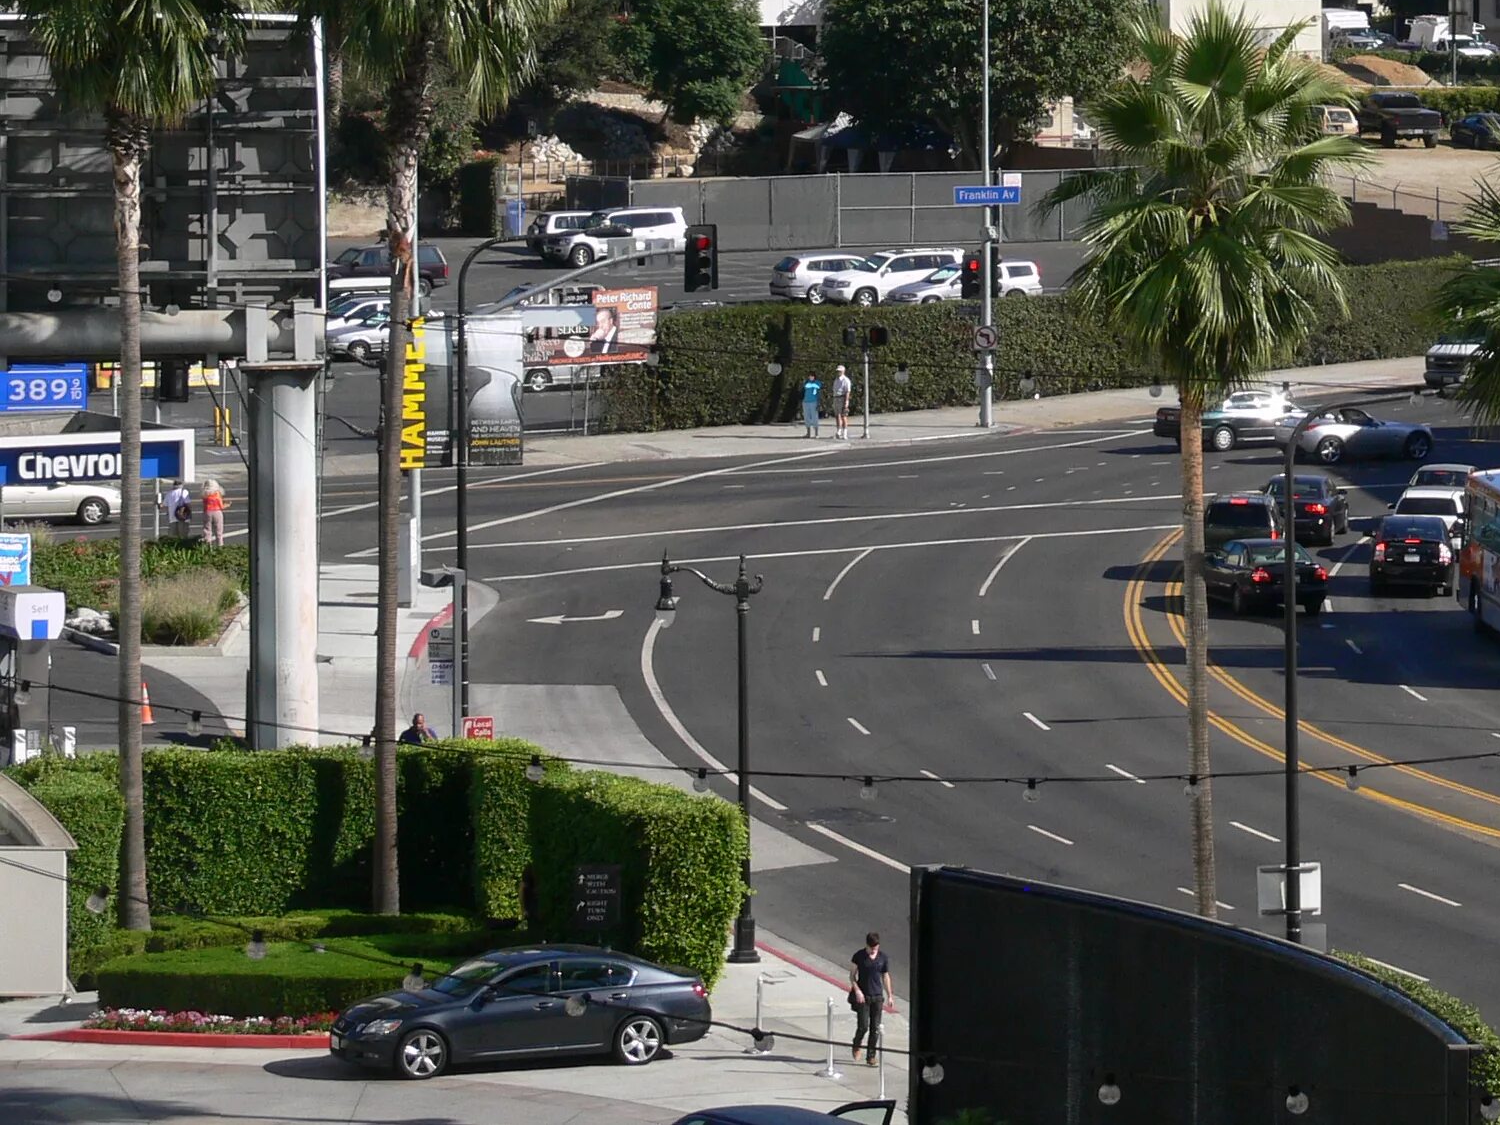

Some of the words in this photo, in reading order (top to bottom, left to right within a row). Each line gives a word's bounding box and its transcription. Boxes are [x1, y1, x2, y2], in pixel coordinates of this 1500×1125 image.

[959, 189, 999, 201] Franklin
[1002, 189, 1015, 201] Av
[596, 294, 618, 303] Peter
[620, 290, 652, 302] Richard
[626, 301, 652, 311] Conte
[9, 379, 68, 401] 389
[18, 452, 122, 480] Chevro
[31, 604, 49, 613] Self
[473, 719, 492, 728] Local
